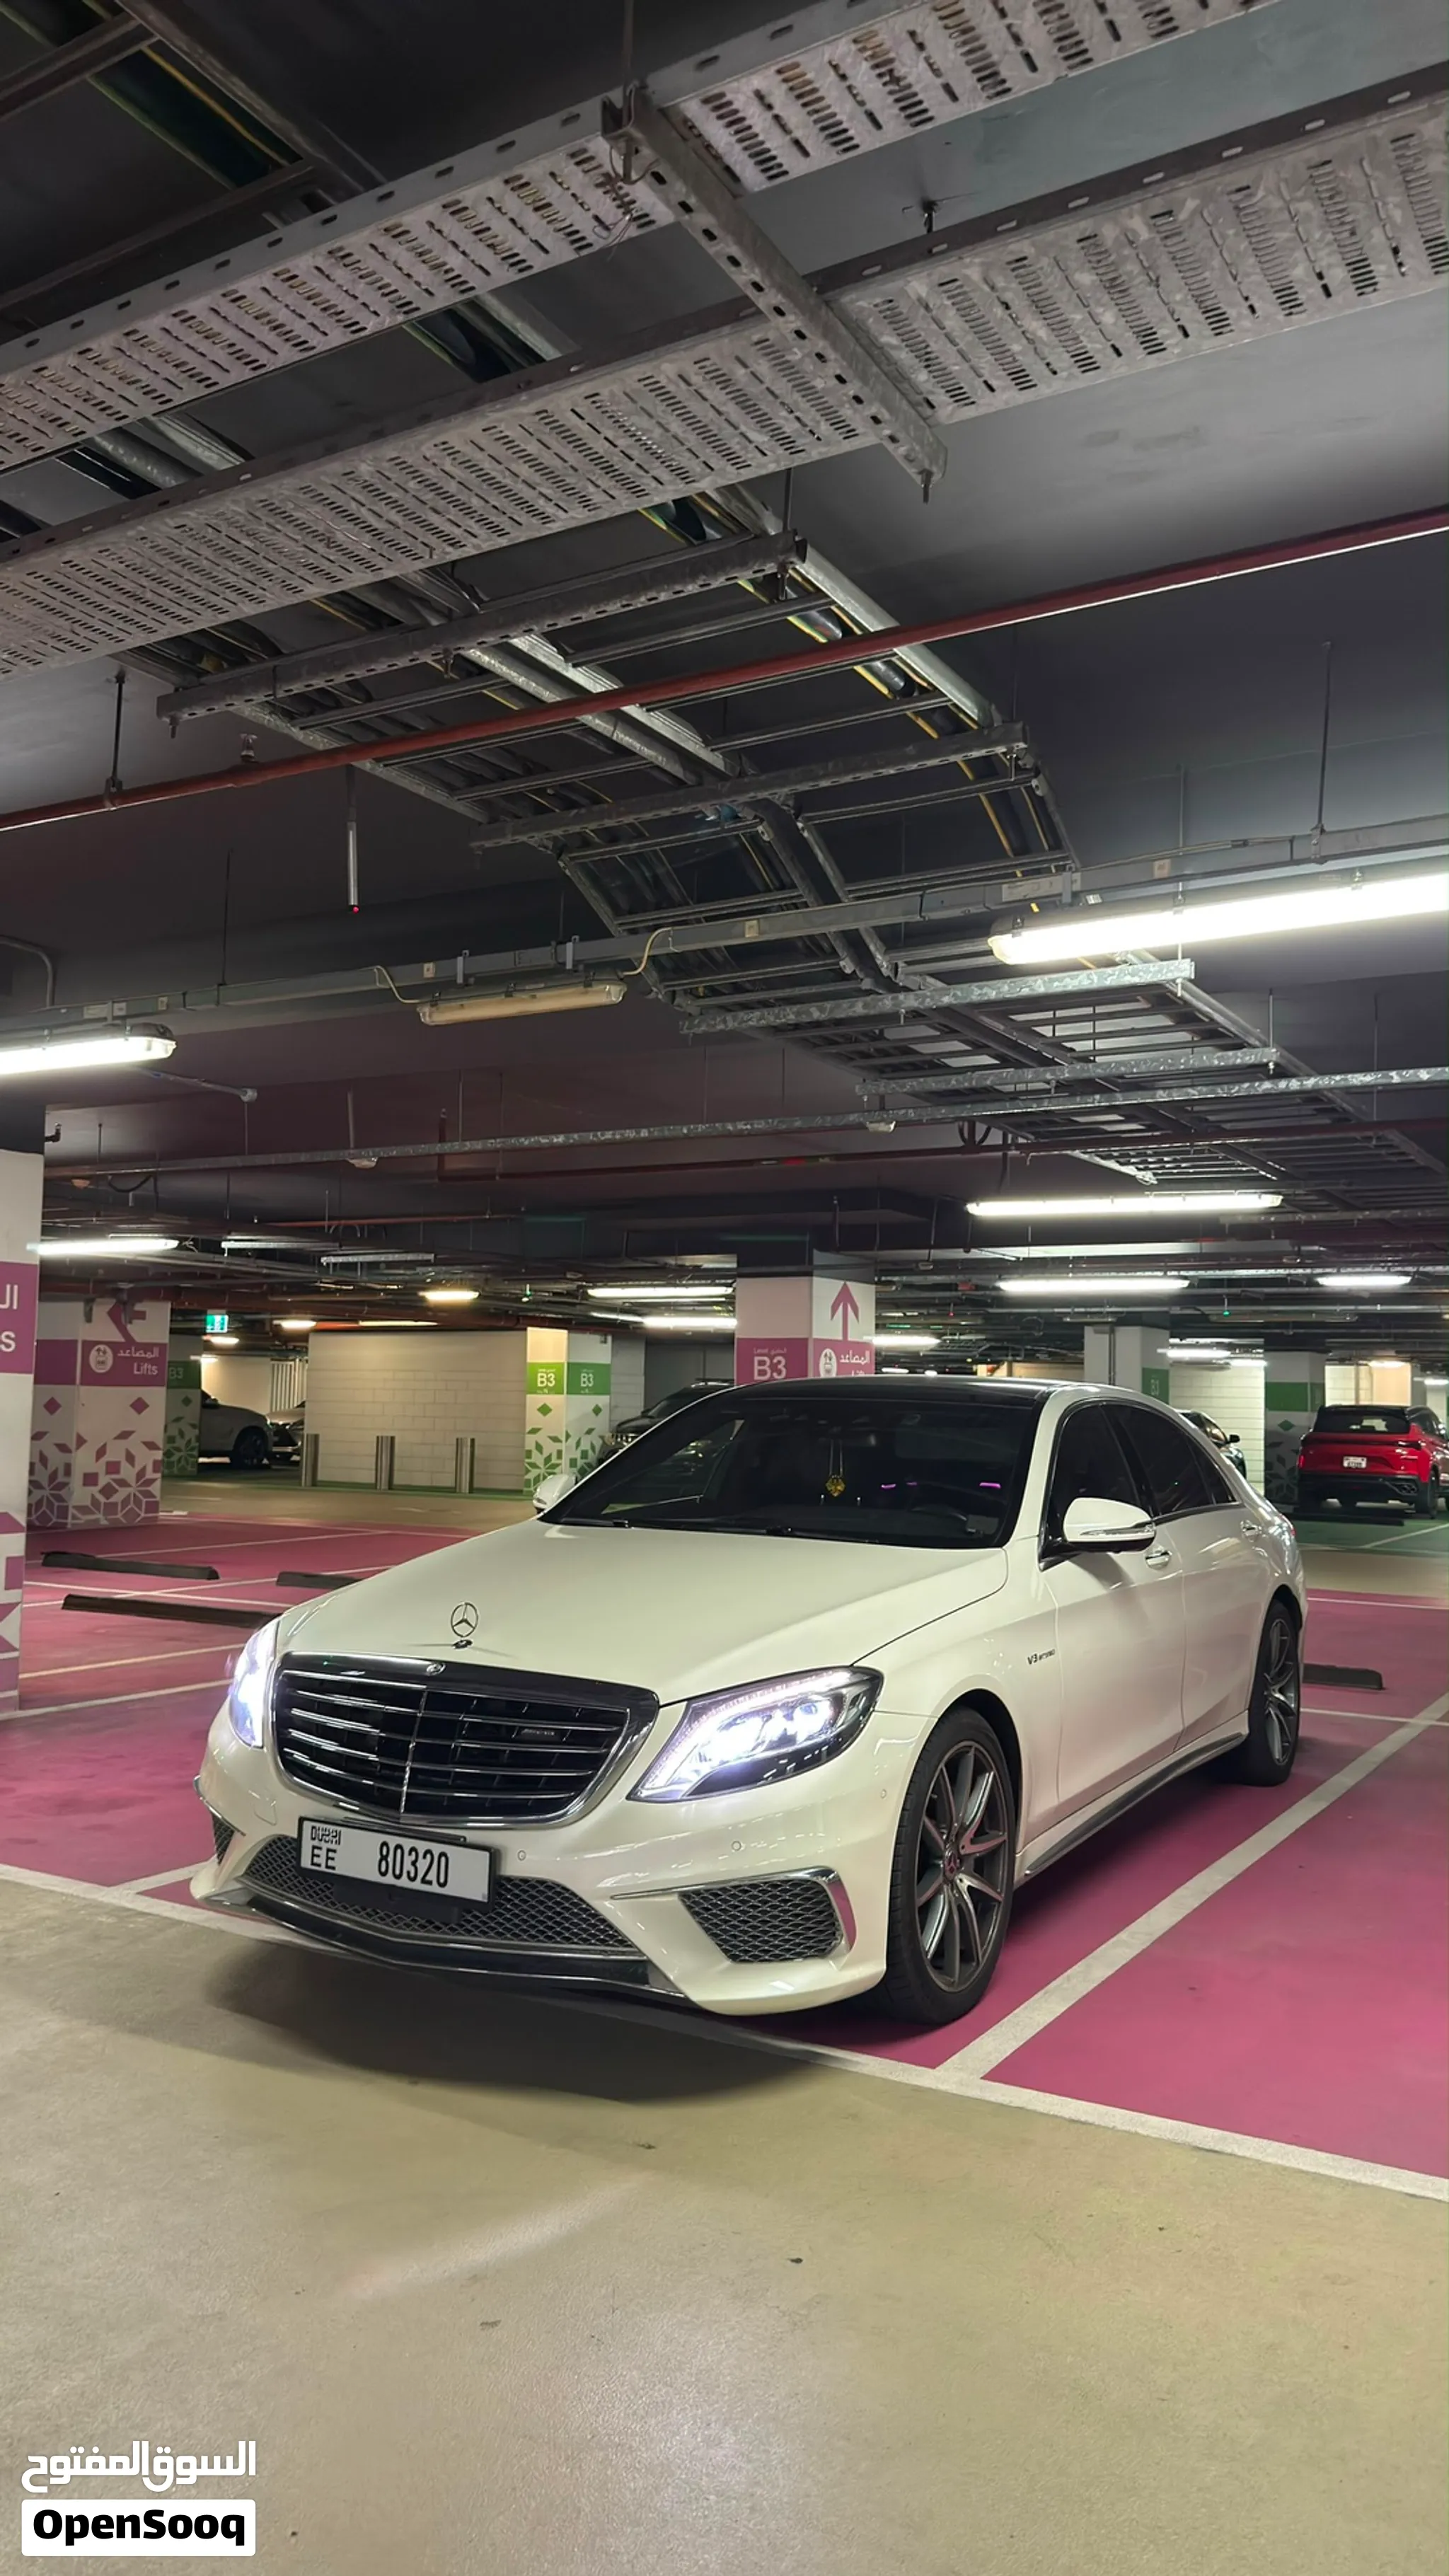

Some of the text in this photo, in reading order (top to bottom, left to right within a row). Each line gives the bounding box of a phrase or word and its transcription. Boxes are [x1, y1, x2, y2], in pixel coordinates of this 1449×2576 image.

[117, 1346, 160, 1359] المصاعد
[839, 1349, 870, 1365] المصاعد
[133, 1362, 158, 1375] Lifts
[754, 1356, 787, 1380] B3
[537, 1372, 556, 1387] B3
[580, 1372, 594, 1387] B3
[310, 1841, 449, 1888] EE 80320
